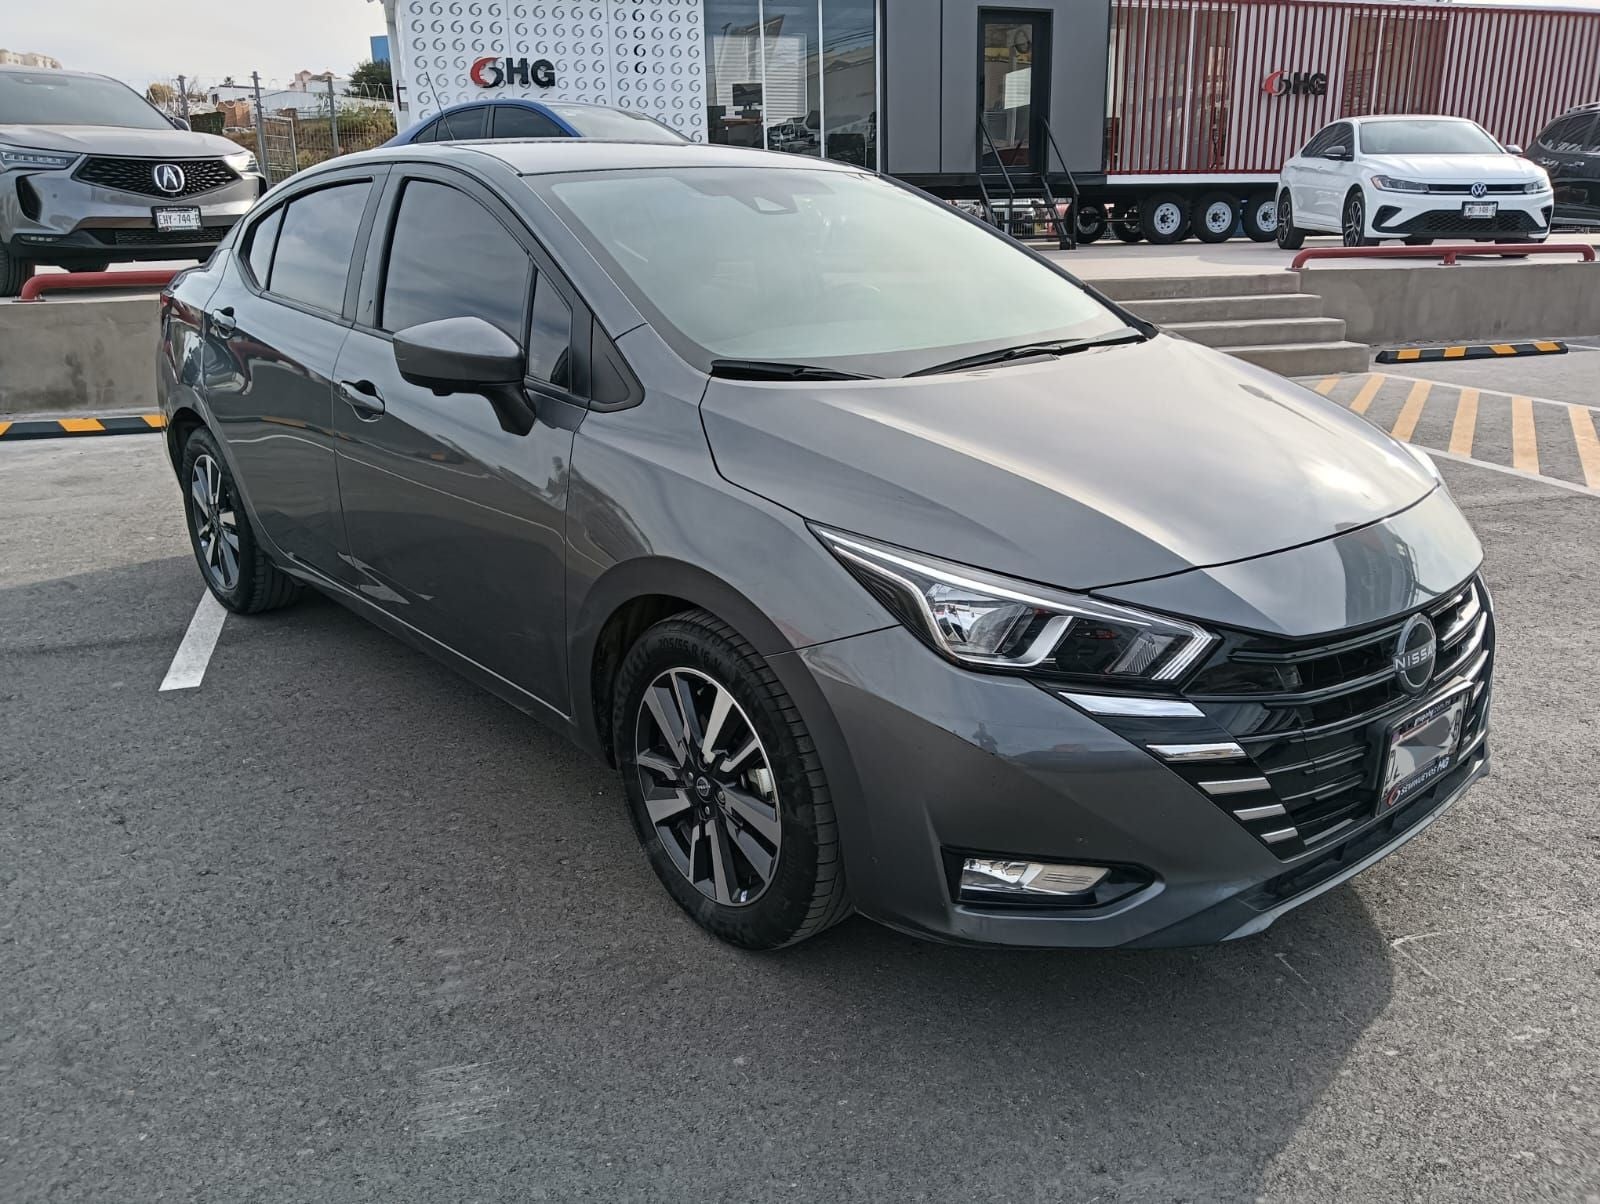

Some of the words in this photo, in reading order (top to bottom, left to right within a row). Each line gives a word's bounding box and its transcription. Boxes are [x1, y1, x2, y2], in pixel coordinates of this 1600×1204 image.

[506, 57, 555, 88] HG
[1293, 72, 1326, 95] HG
[1395, 644, 1436, 671] NISSA
